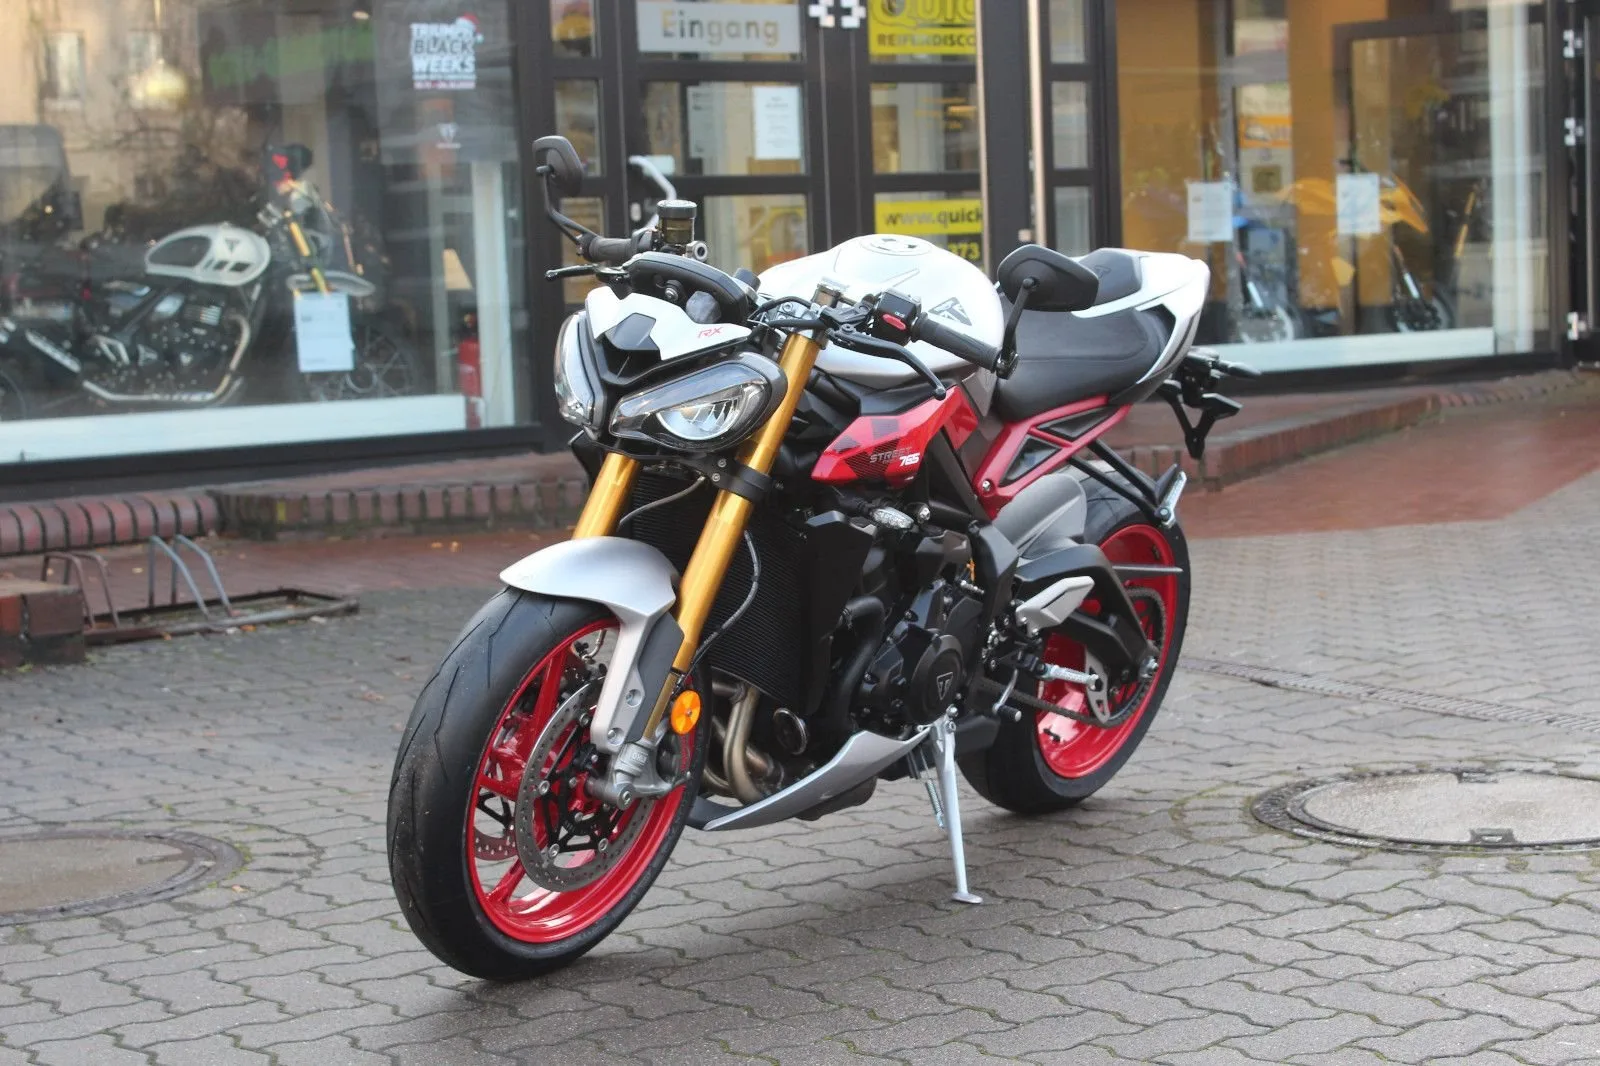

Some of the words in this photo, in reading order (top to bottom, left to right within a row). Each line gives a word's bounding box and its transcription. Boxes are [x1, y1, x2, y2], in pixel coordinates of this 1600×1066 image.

[662, 9, 780, 48] Eingang
[414, 38, 474, 55] BLACK
[412, 56, 475, 74] WEEKS
[698, 326, 724, 338] RX
[869, 447, 913, 463] STREET
[899, 452, 921, 467] 765
